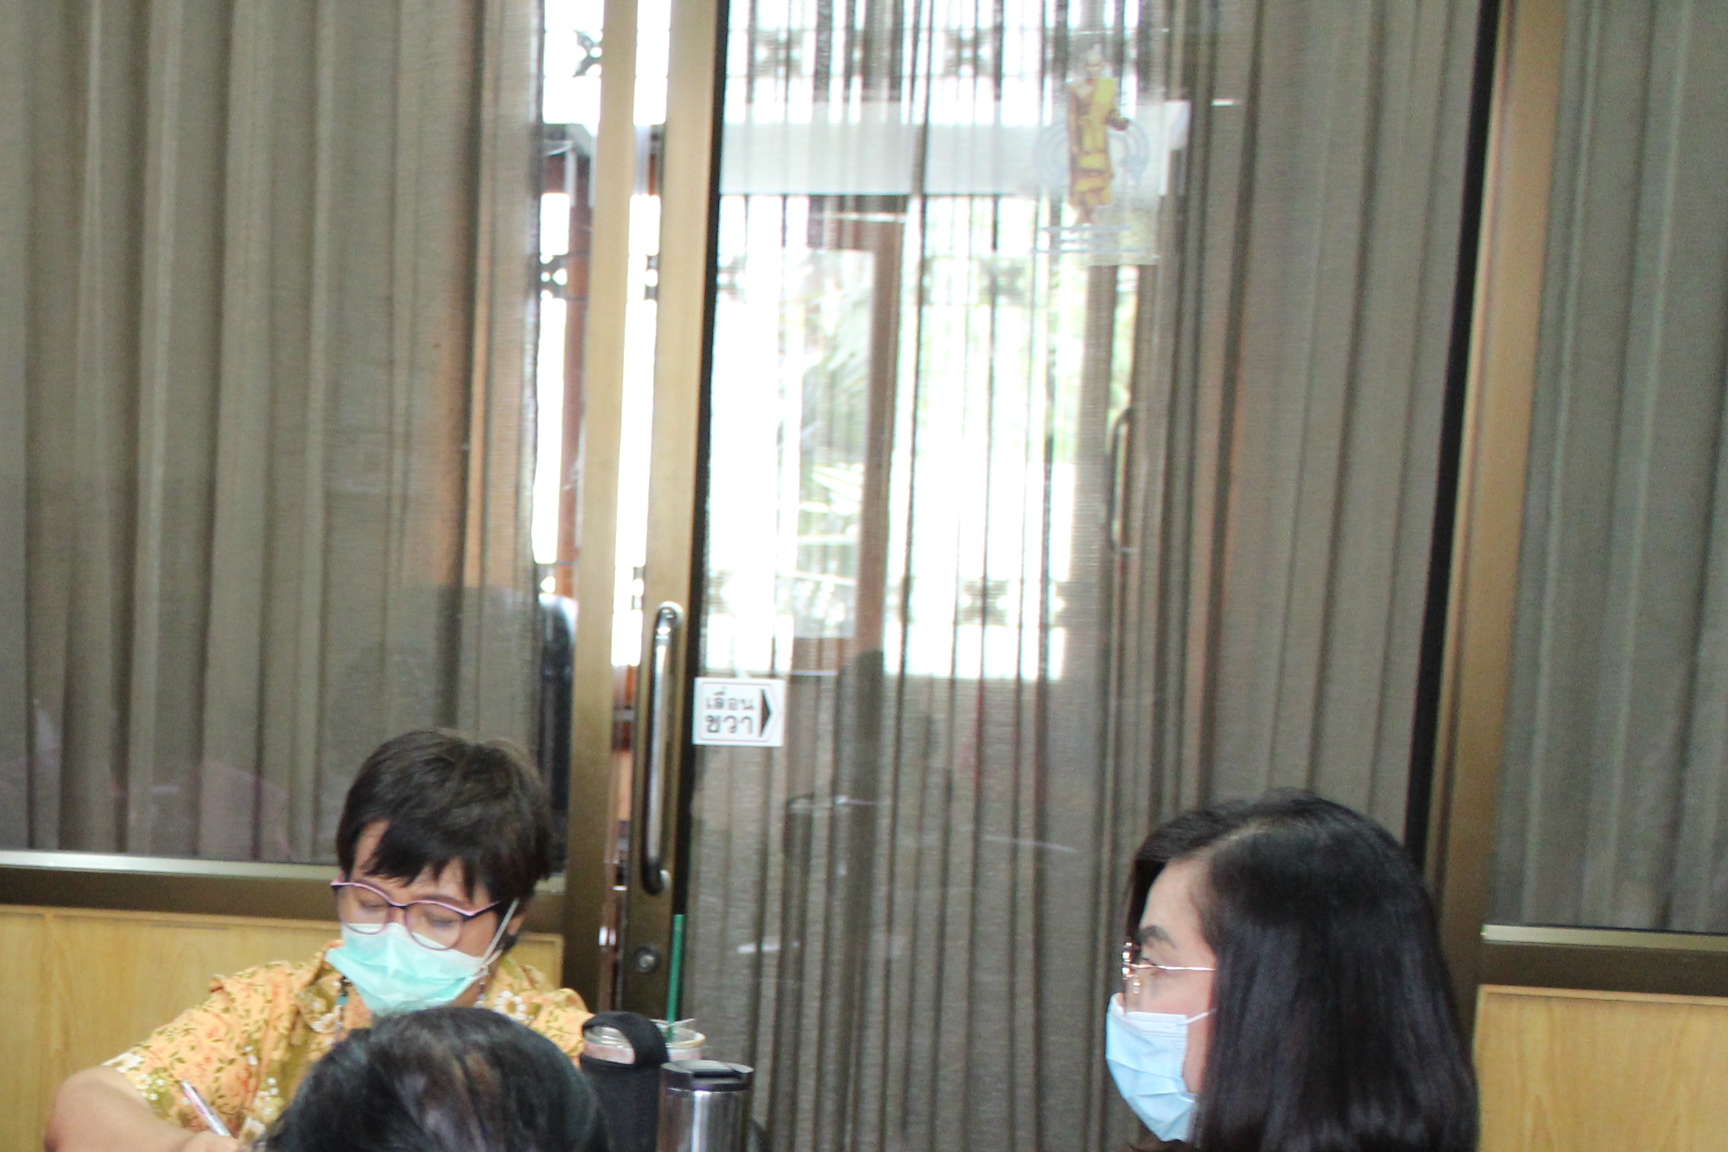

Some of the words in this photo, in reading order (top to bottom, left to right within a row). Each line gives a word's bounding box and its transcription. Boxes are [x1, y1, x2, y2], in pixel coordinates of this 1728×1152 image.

[705, 686, 755, 711] เลื่อน
[705, 715, 753, 734] ขวา
